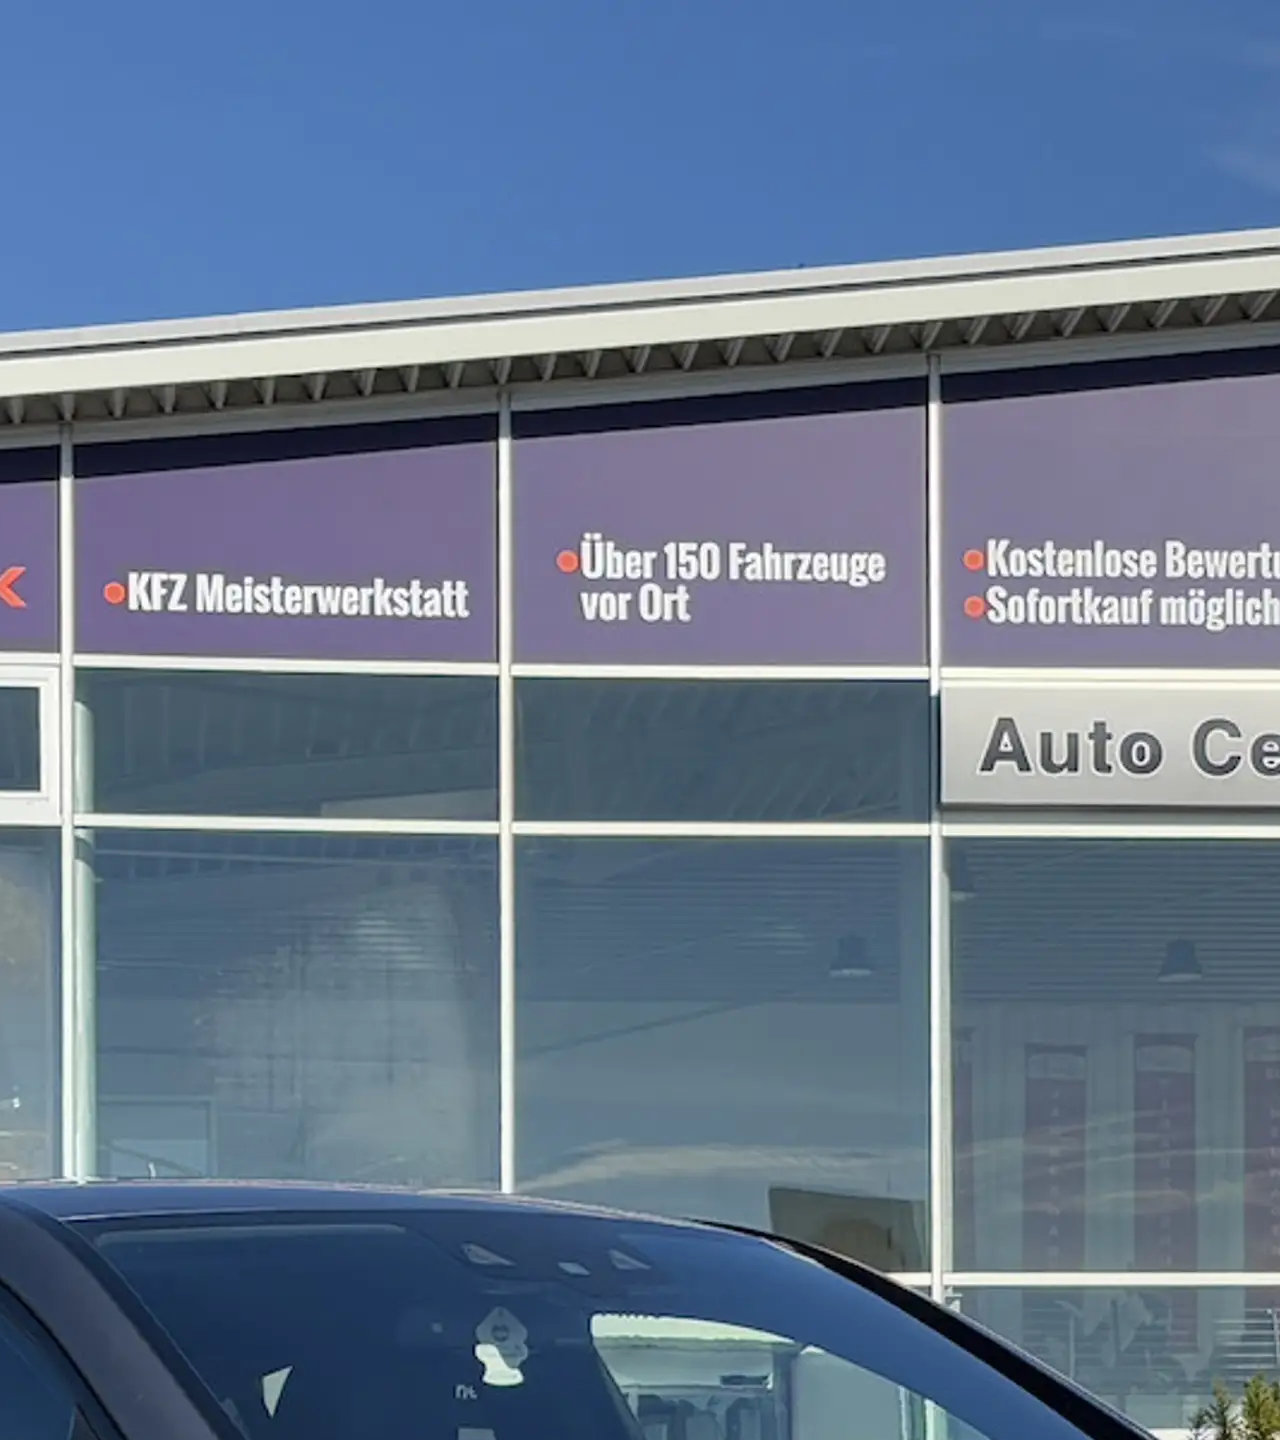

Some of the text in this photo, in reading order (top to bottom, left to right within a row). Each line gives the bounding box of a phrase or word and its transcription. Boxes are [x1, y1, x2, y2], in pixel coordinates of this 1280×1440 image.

[580, 533, 886, 588] Über 150 Fahrzeuge
[987, 539, 1157, 579] Kostenlose
[127, 572, 470, 618] KFZ Meisterwerkstatt
[580, 583, 691, 622] vor Ort
[987, 587, 1153, 625] Sofortkauf
[978, 716, 1165, 778] Auto
